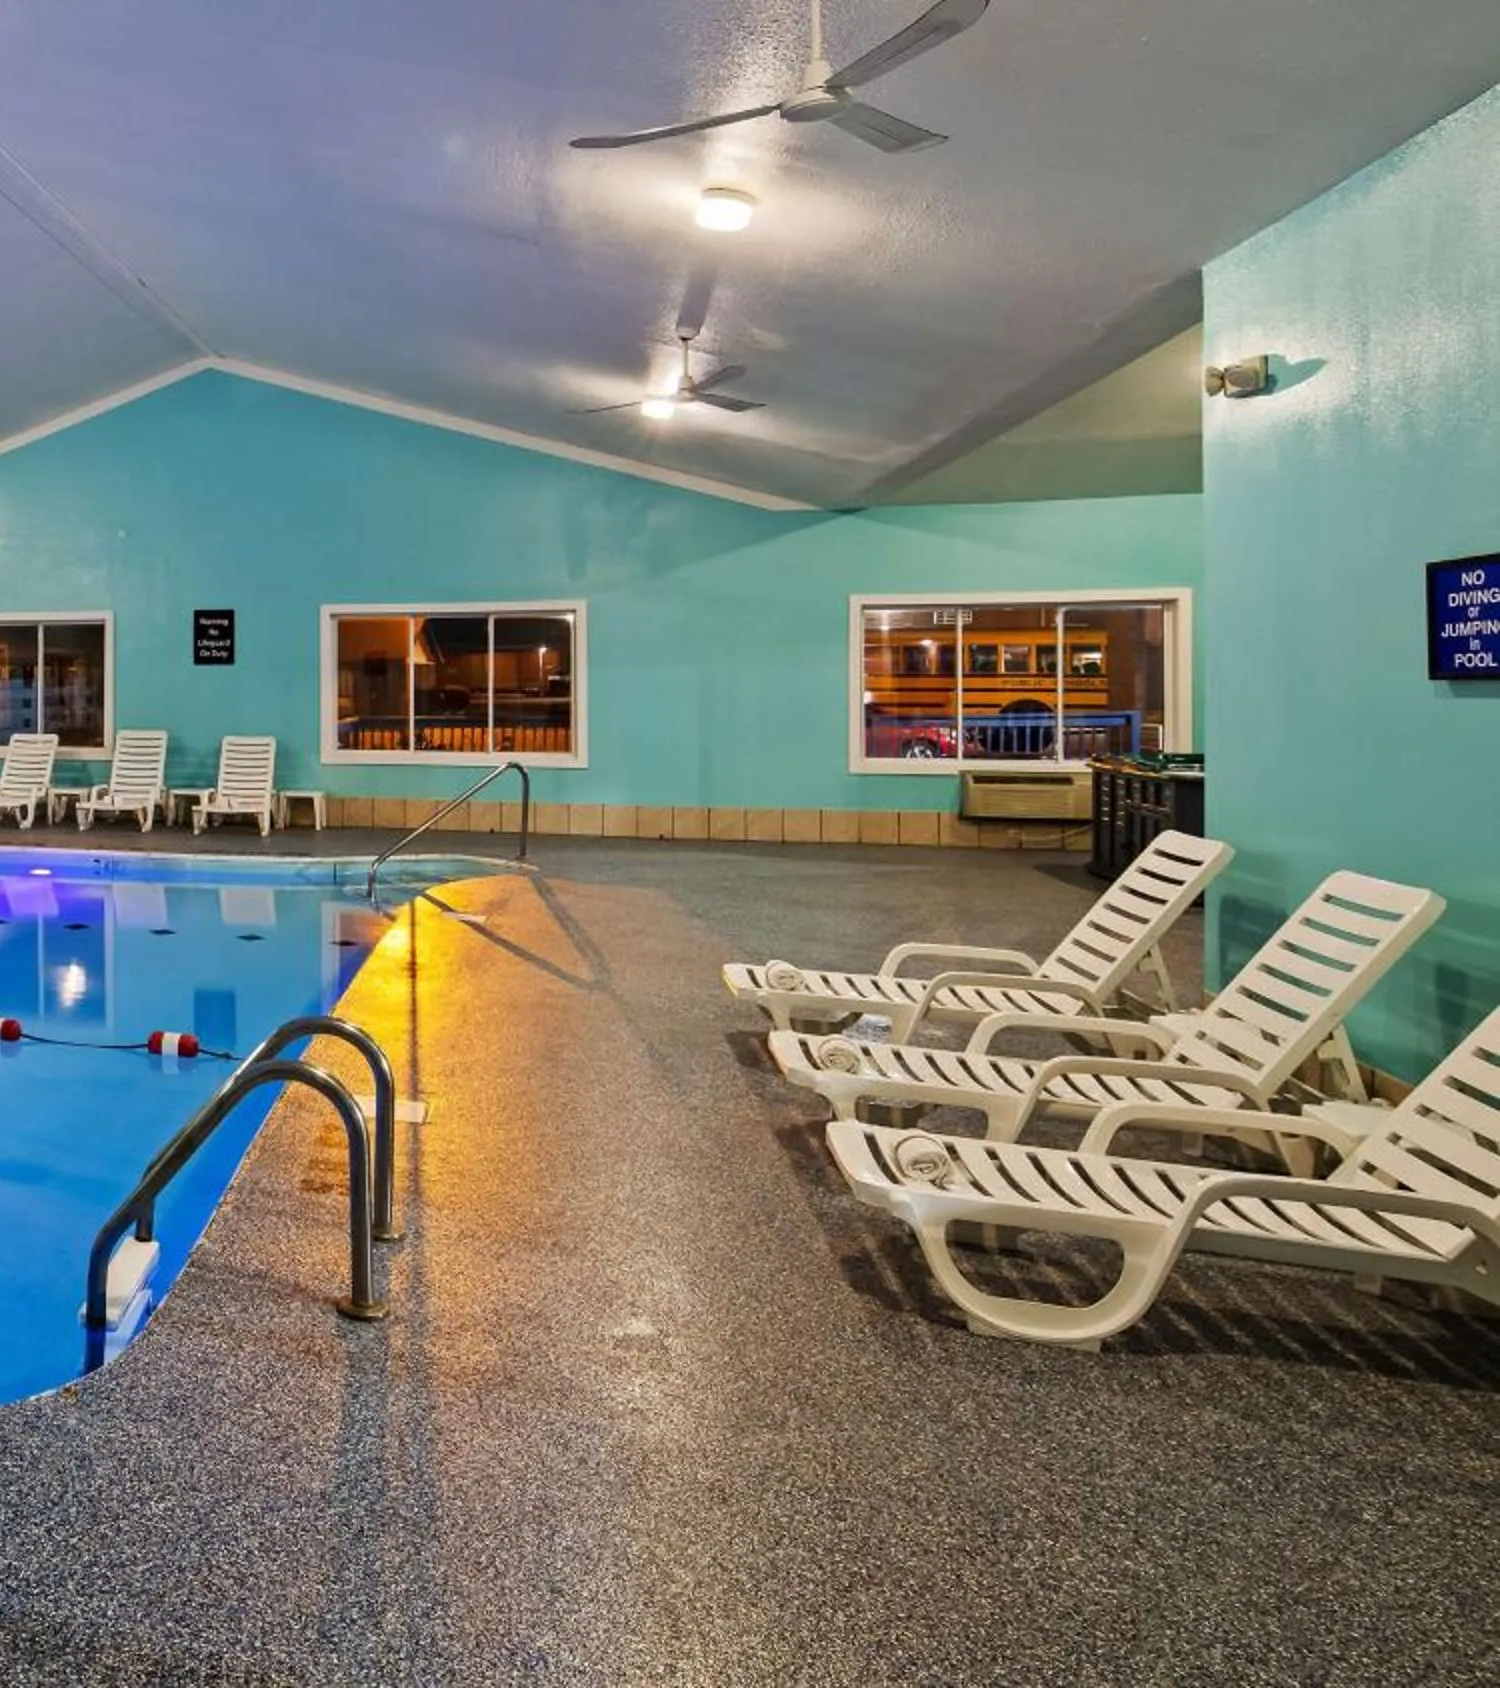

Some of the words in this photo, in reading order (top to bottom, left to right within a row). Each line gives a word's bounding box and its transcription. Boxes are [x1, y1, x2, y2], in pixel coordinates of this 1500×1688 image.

[1461, 570, 1485, 586] NO
[1448, 588, 1500, 607] DIVING
[1468, 606, 1480, 618] or
[1441, 619, 1500, 638] JUMPIN
[1469, 637, 1481, 651] in
[1454, 652, 1498, 667] POOL
